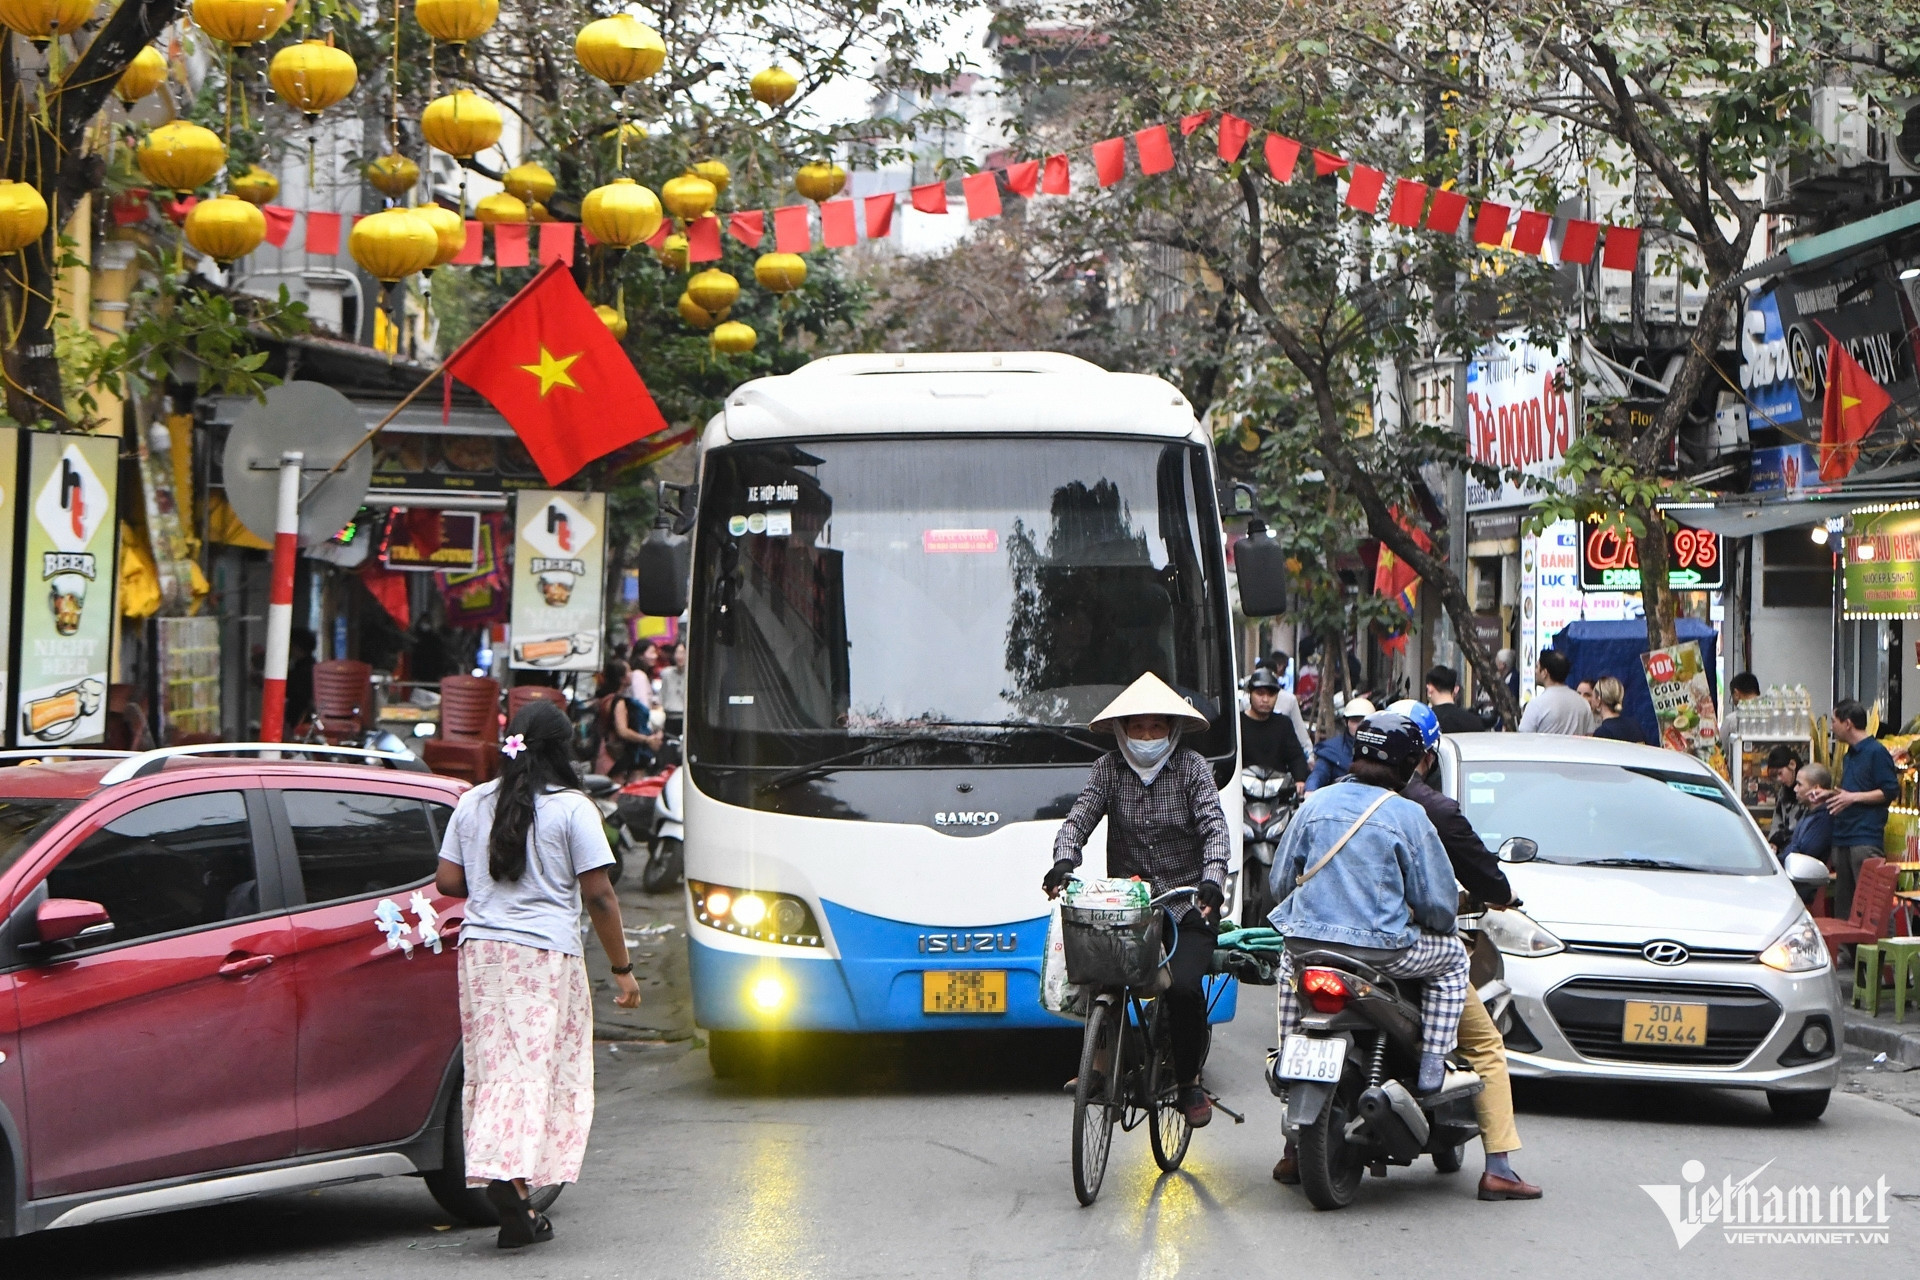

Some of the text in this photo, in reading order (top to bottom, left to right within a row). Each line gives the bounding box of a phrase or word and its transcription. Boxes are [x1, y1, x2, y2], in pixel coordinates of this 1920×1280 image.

[1863, 333, 1896, 386] DUY
[1498, 396, 1543, 473] ngon
[1543, 369, 1569, 459] 93
[747, 486, 759, 502] XE
[1674, 528, 1718, 568] 93
[44, 553, 96, 579] BEER
[532, 558, 585, 575] BEER
[1541, 551, 1574, 569] BÁNH
[1541, 574, 1565, 588] LỤC
[33, 639, 99, 657] NIGHT
[41, 658, 89, 675] BEER
[1650, 659, 1673, 676] 10K
[1654, 682, 1681, 696] COLD
[1657, 694, 1689, 710] DRINK
[935, 812, 999, 826] SAMCO
[919, 933, 1017, 953] ISUZU
[1649, 1005, 1683, 1023] 30A
[1634, 1024, 1697, 1043] 749.44
[1287, 1058, 1337, 1079] 151.89
